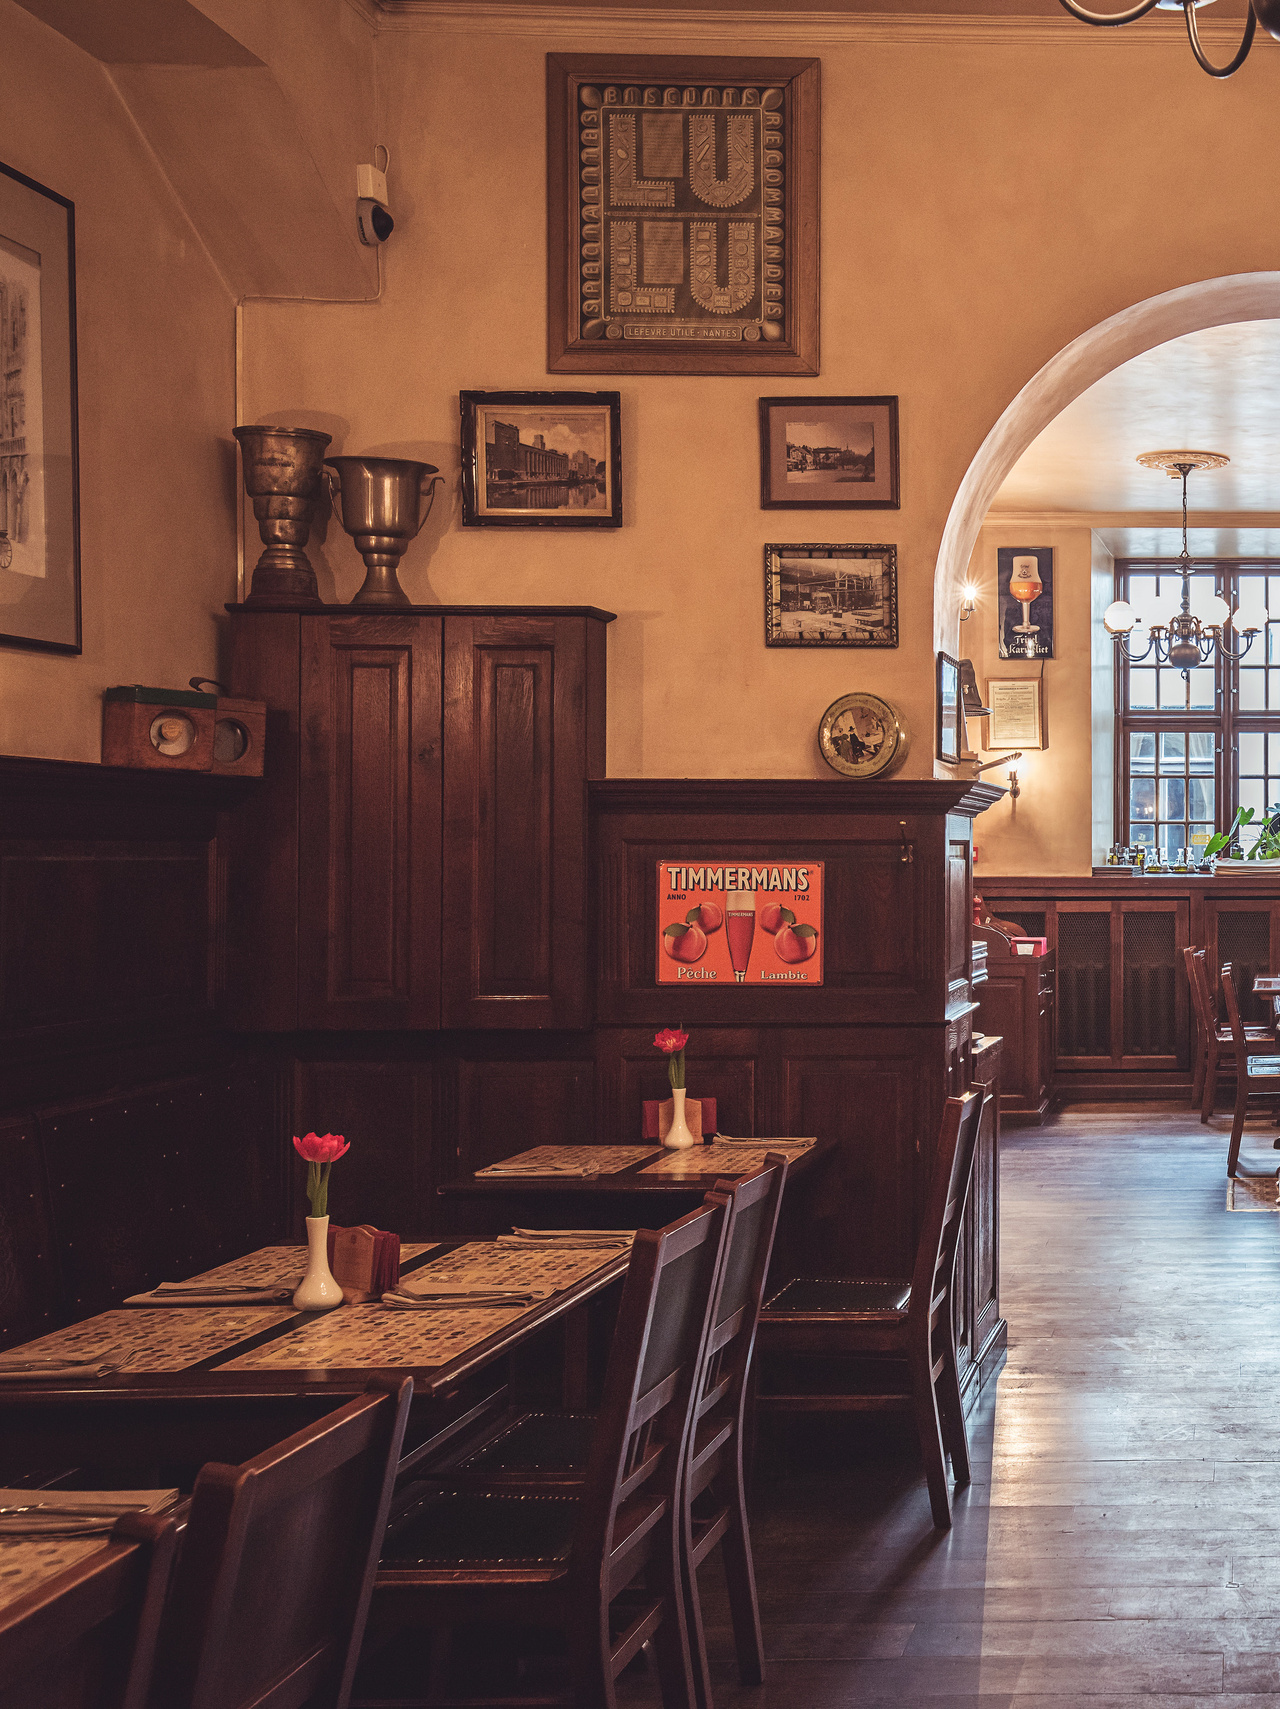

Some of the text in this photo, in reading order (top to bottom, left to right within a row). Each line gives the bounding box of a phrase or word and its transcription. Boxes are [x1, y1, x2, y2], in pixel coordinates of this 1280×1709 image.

[606, 89, 756, 105] BISCUITS
[670, 328, 695, 337] UTILE
[703, 329, 737, 338] NANTES
[667, 867, 811, 892] TIMMERMANS
[666, 893, 687, 901] ANNO
[794, 894, 810, 902] 1702
[677, 967, 717, 980] Pêche
[761, 970, 808, 980] Lambic
